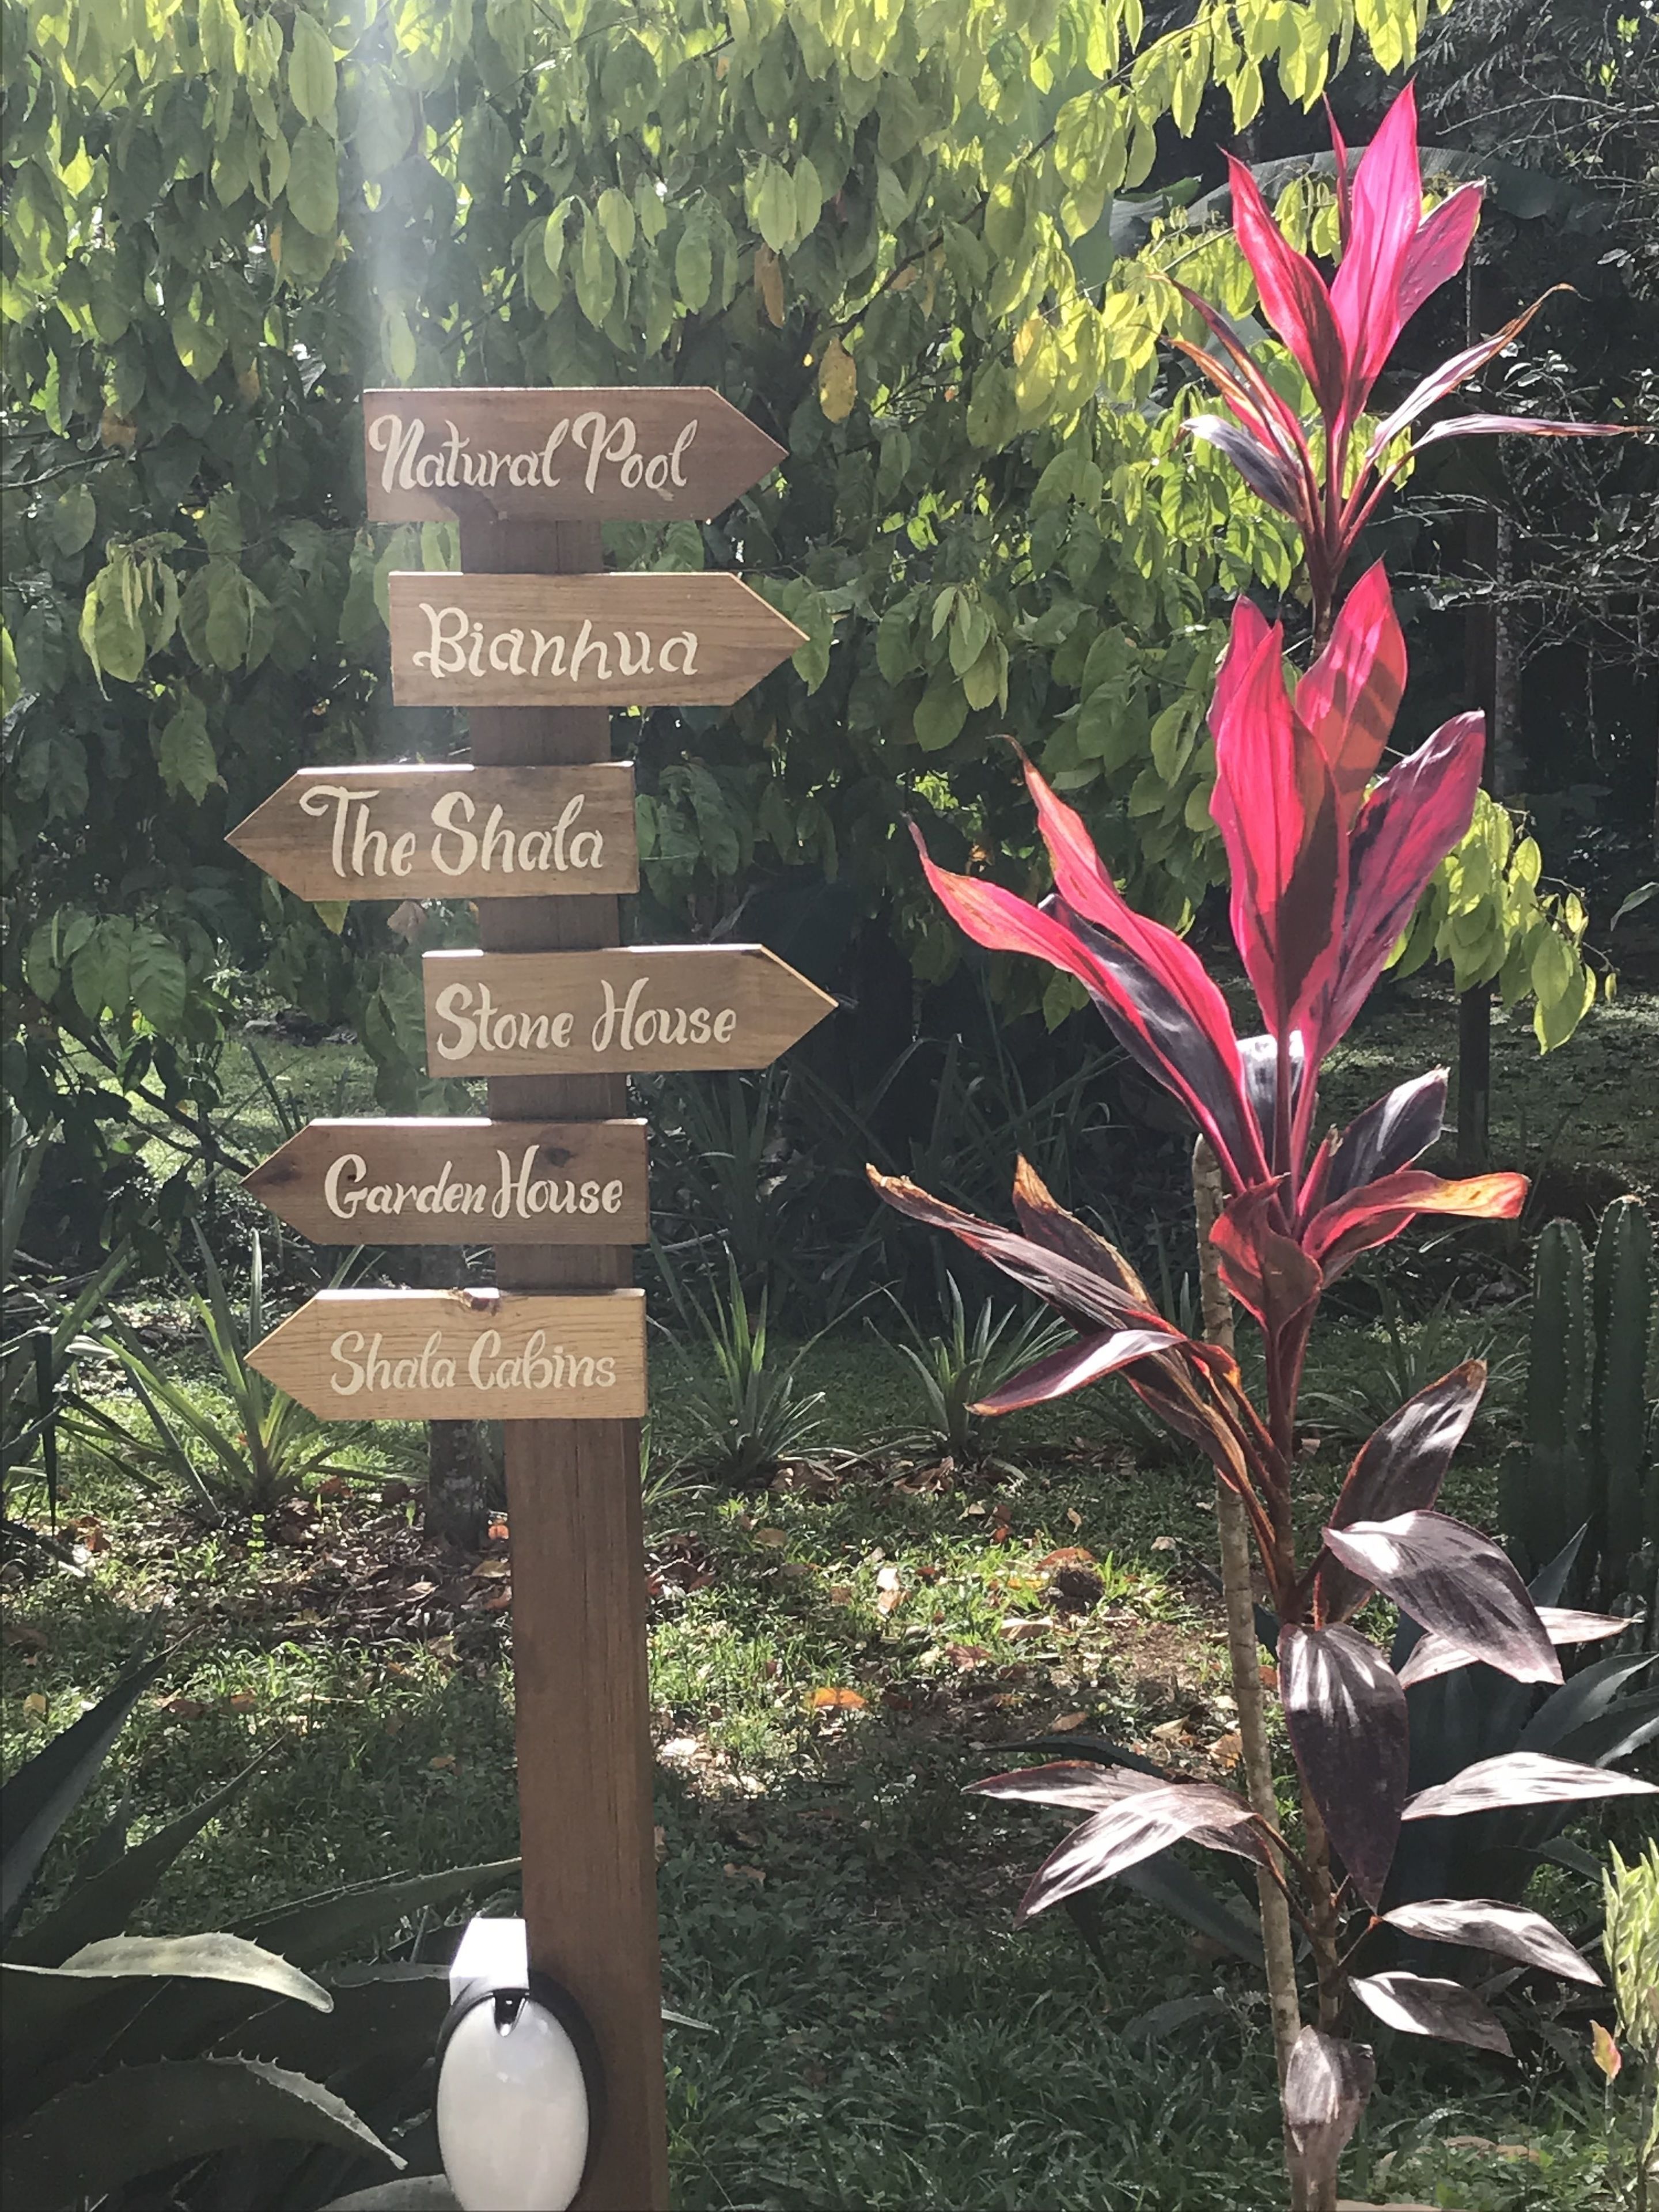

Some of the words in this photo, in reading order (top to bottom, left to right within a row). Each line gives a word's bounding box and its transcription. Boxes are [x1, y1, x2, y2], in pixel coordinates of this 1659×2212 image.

[369, 414, 570, 494] Natural
[571, 411, 698, 494] Pool
[412, 603, 699, 682] Bianhua
[299, 785, 416, 878] The
[430, 791, 604, 877] Shala
[434, 982, 573, 1060] Stone
[592, 977, 737, 1052] House
[324, 1153, 487, 1219] Garden
[491, 1144, 623, 1219] House
[329, 1330, 457, 1396] Shala
[468, 1328, 617, 1391] Cabins
